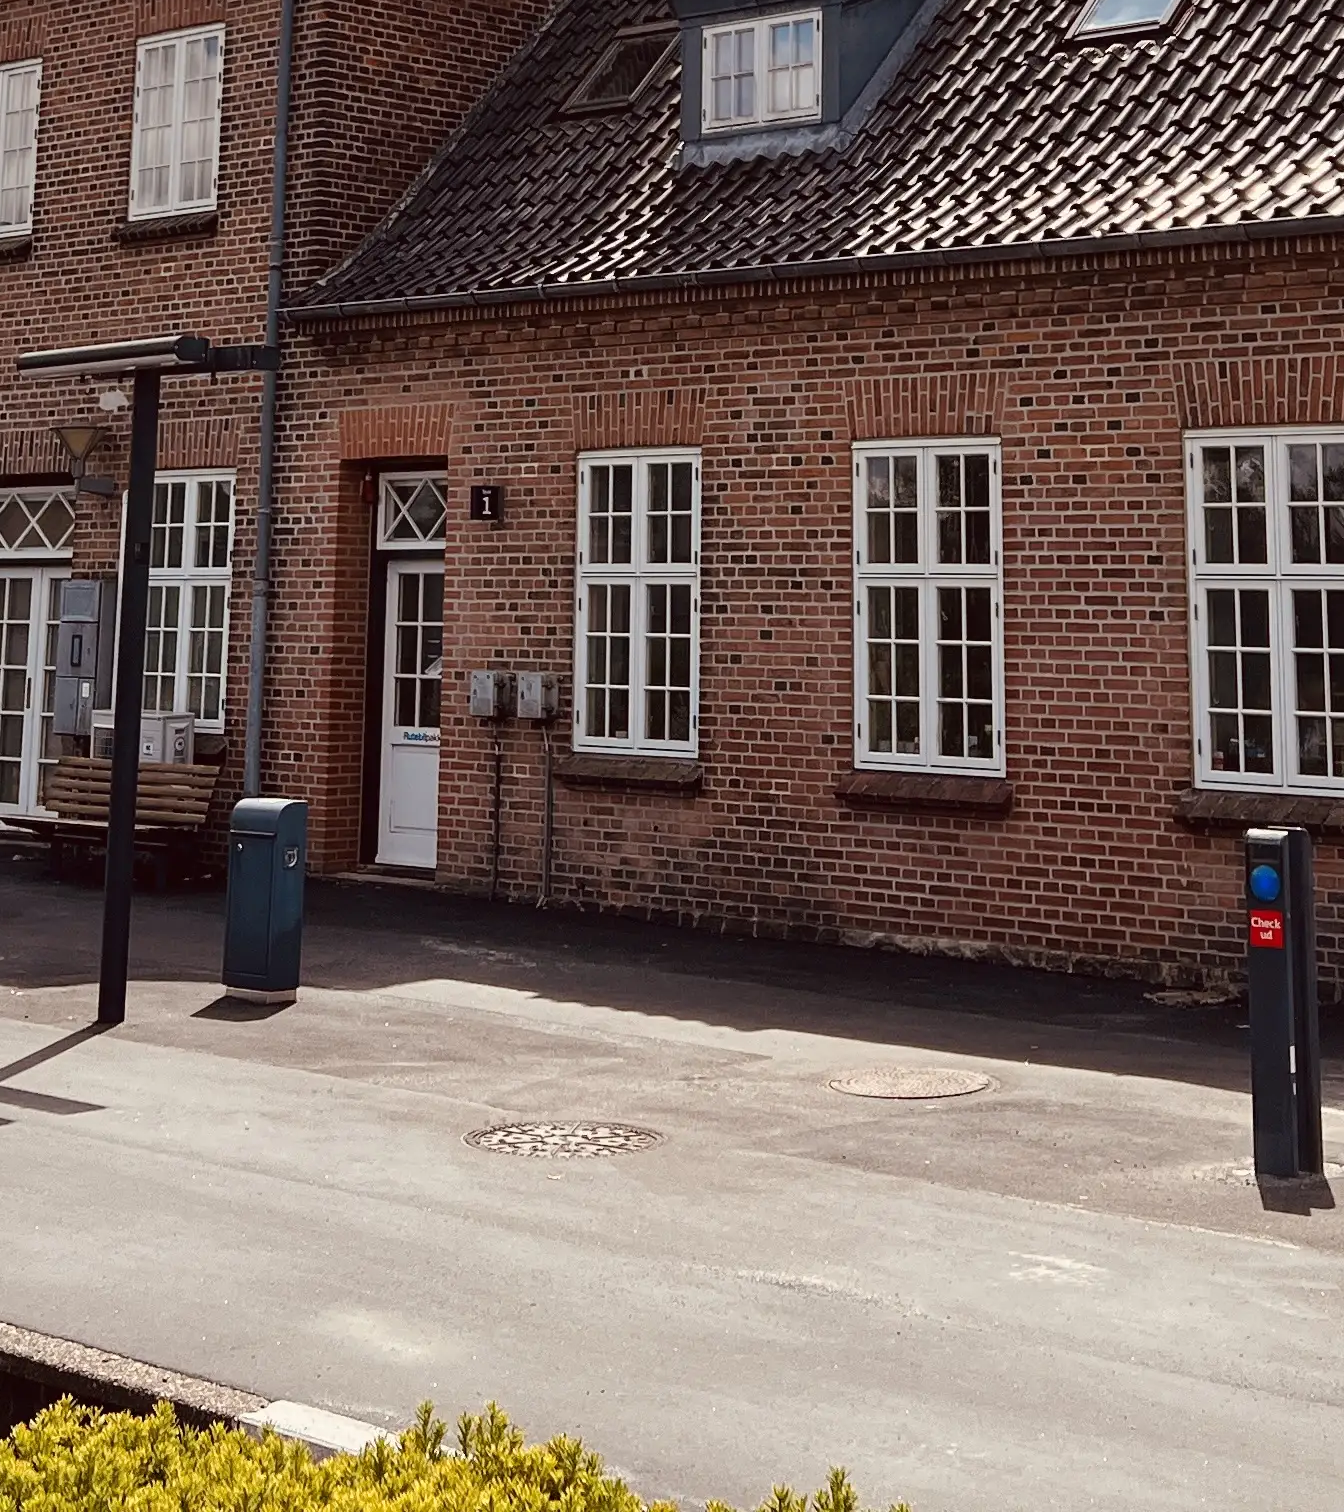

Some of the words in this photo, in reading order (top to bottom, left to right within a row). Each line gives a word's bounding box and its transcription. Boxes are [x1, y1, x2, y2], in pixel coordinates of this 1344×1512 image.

[482, 496, 492, 515] 1
[1250, 916, 1282, 930] Check
[1259, 929, 1273, 940] ud
